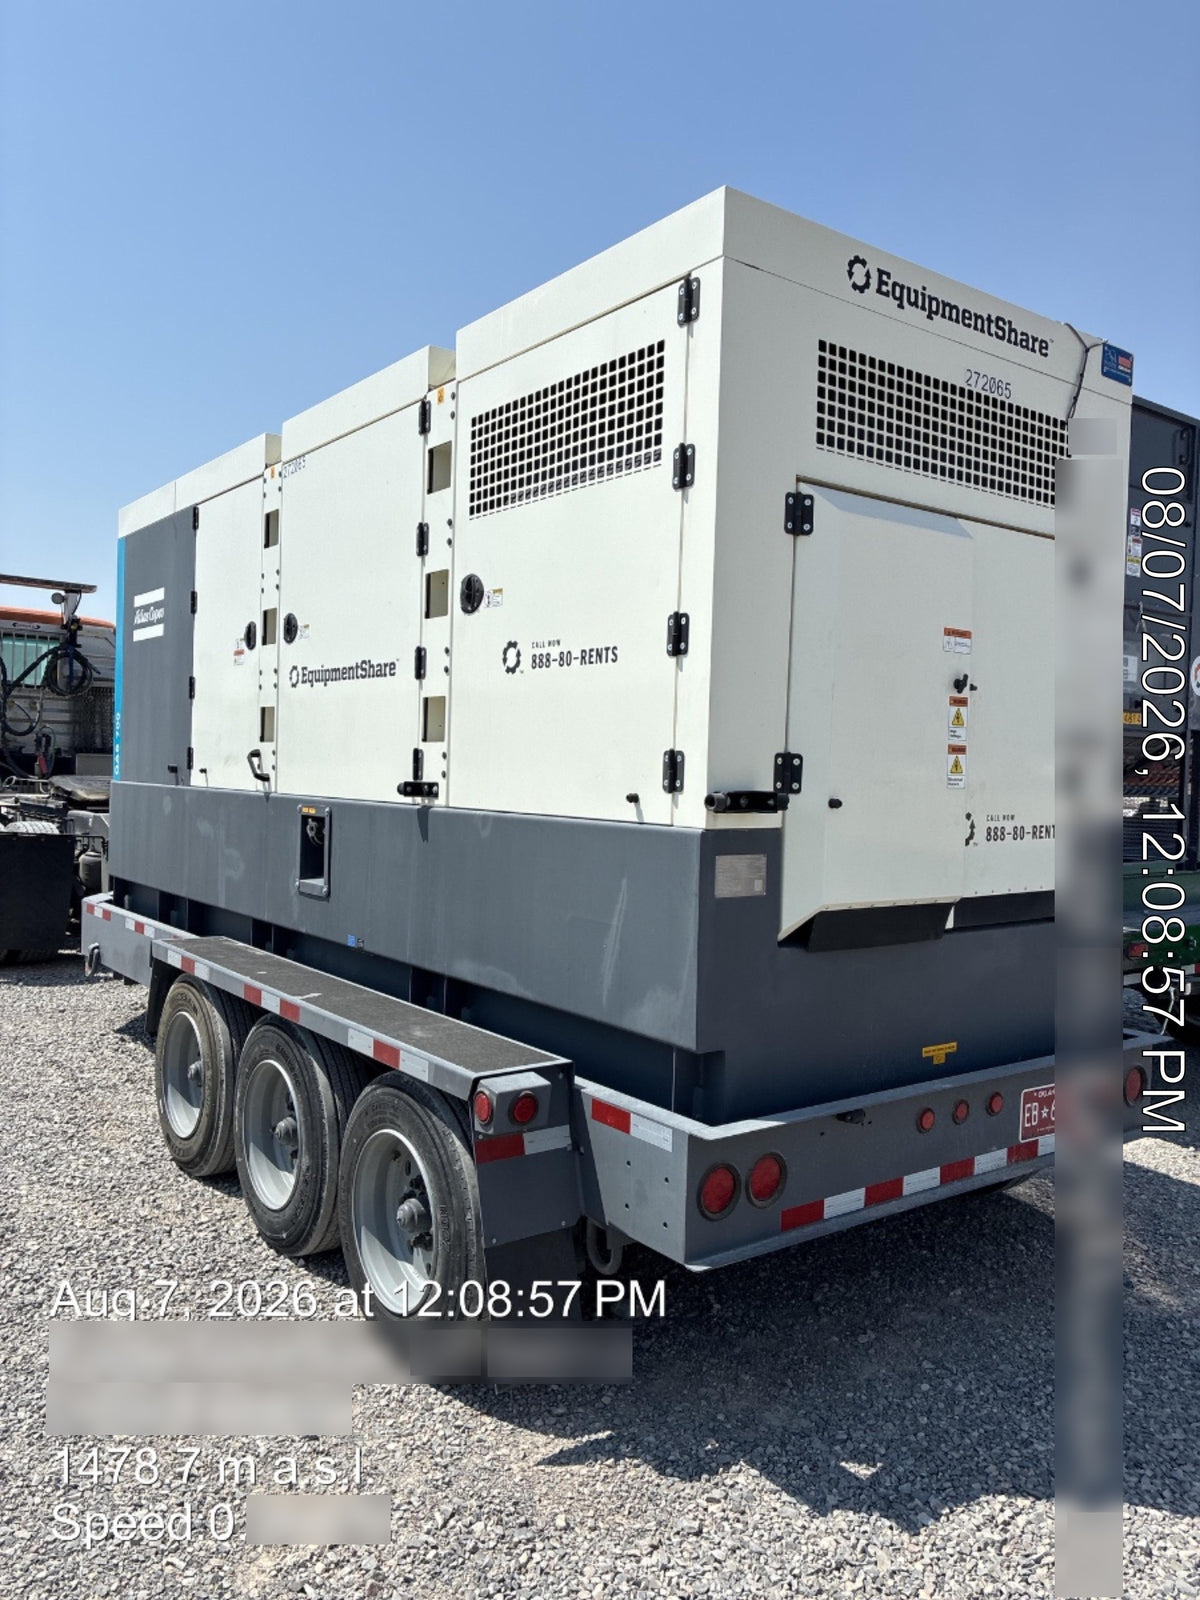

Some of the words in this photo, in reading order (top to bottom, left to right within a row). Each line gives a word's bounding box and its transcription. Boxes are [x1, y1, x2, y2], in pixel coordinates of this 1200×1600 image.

[876, 267, 1049, 358] EquipmentShare
[966, 368, 1012, 400] 272065
[531, 641, 546, 649] CALL
[547, 639, 561, 648] NOW
[531, 645, 619, 669] 888-80-RENTS
[301, 660, 397, 688] EquipmentShare
[986, 814, 1001, 822] CALL
[1002, 814, 1016, 822] NOW
[985, 825, 1055, 842] 888-80-RENT
